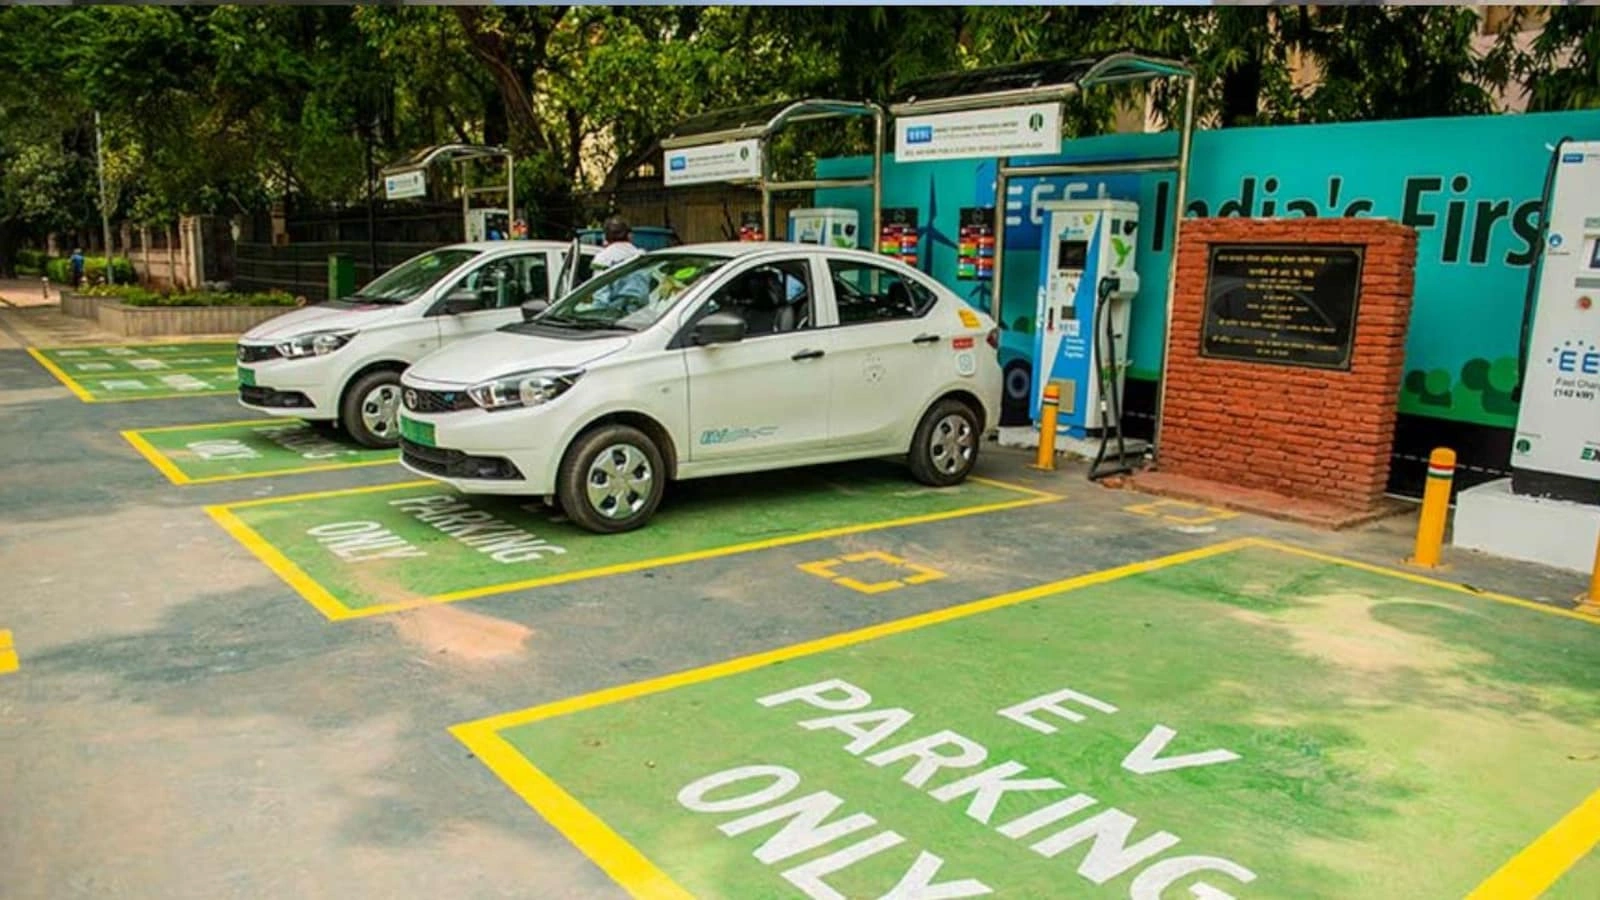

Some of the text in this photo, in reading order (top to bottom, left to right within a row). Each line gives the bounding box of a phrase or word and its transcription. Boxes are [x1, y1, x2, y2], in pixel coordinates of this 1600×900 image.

[306, 520, 428, 562] ONLY
[388, 495, 567, 563] PARKING
[676, 764, 994, 900] ONLY
[755, 678, 1258, 900] PARKING
